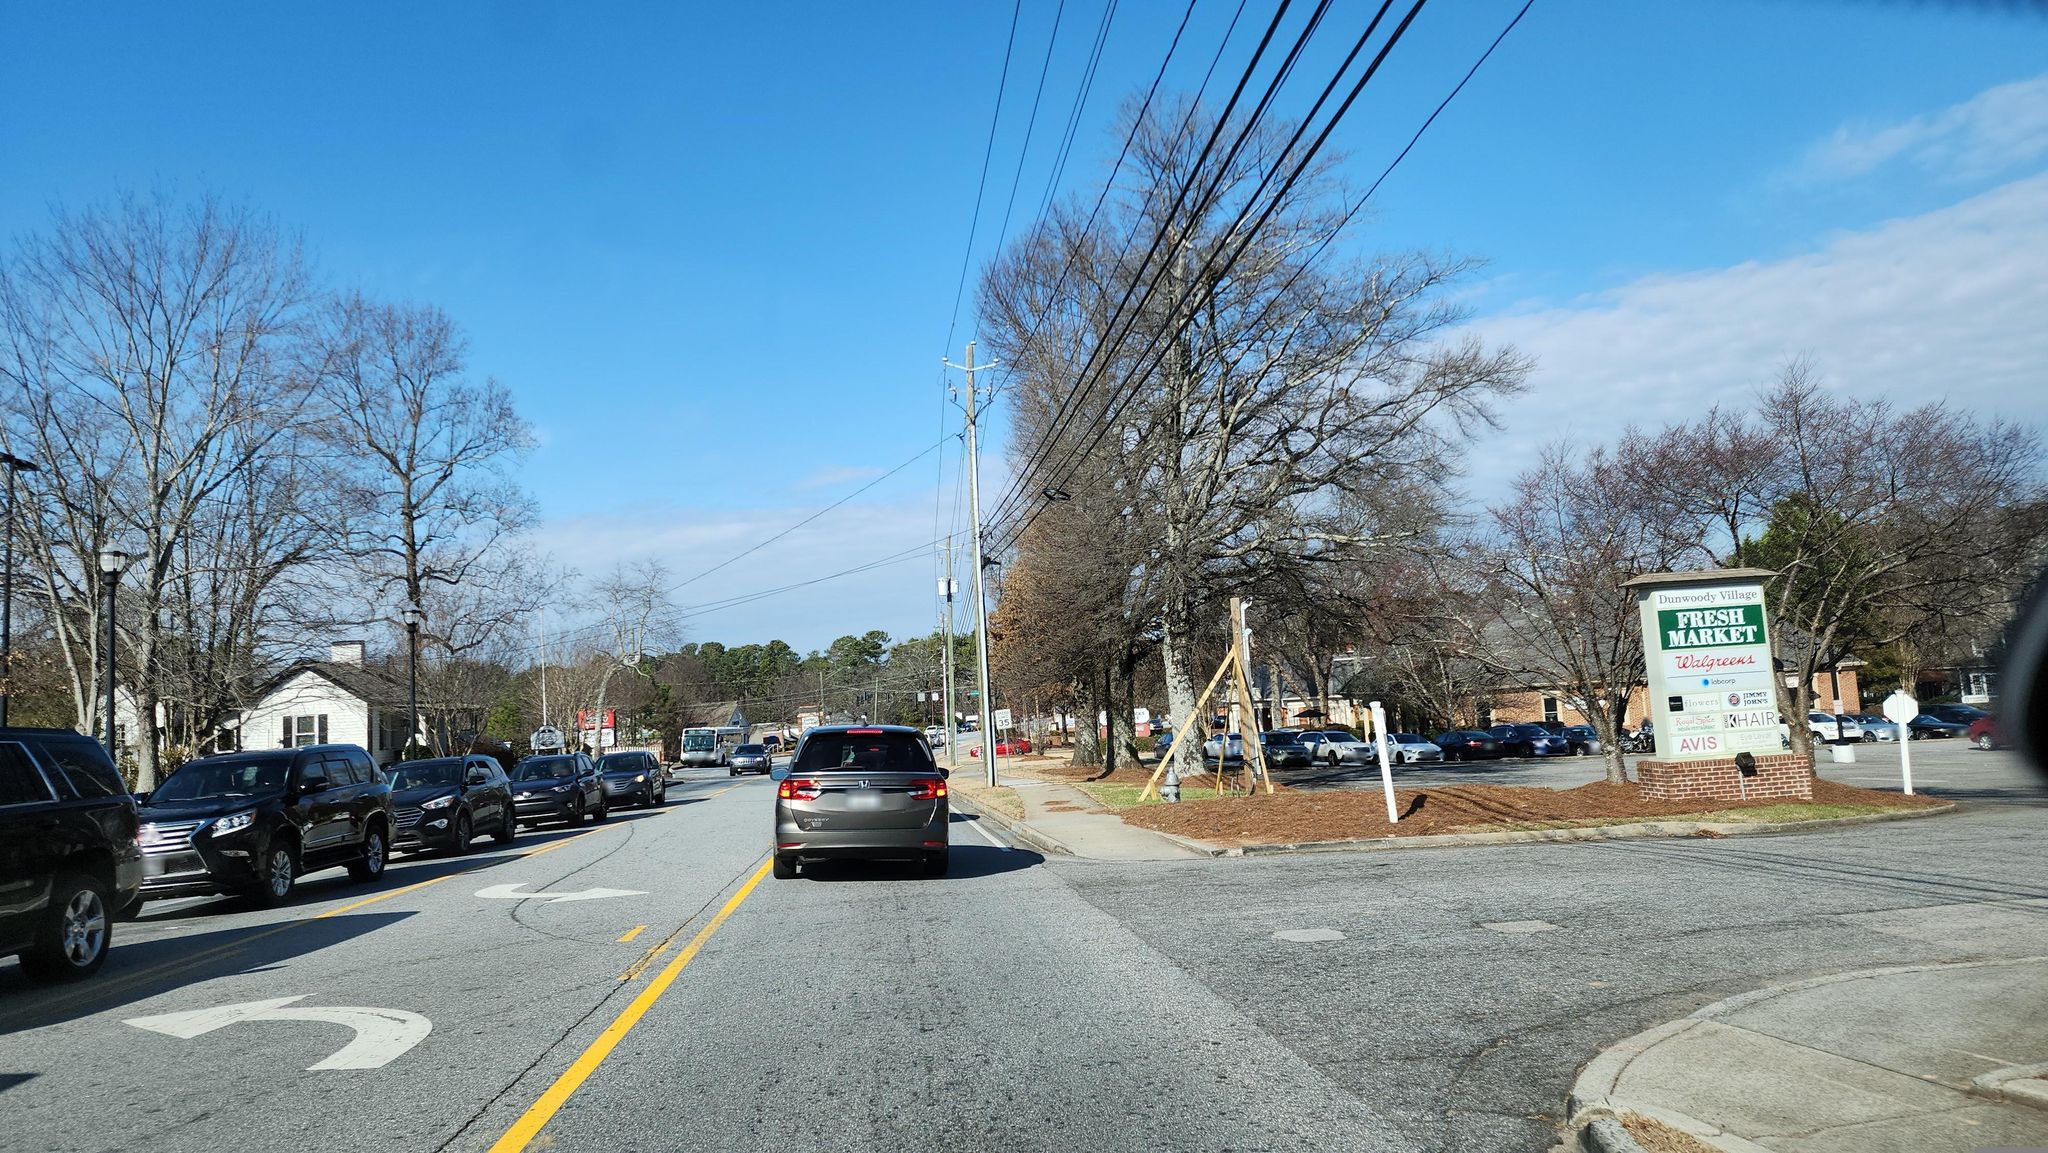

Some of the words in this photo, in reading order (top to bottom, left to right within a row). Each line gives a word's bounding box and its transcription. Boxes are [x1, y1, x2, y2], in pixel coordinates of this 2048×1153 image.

[1659, 592, 1717, 604] Dunwoody
[1719, 590, 1758, 601] Village
[1676, 608, 1746, 629] FRESH
[1667, 625, 1758, 647] MARKET
[1675, 654, 1757, 672] Walgreens
[1711, 677, 1736, 686] labcorp
[1743, 691, 1768, 700] JIMMY
[1743, 698, 1769, 707] JOHN'S
[998, 718, 1010, 726] 35
[1680, 736, 1717, 752] AVIS
